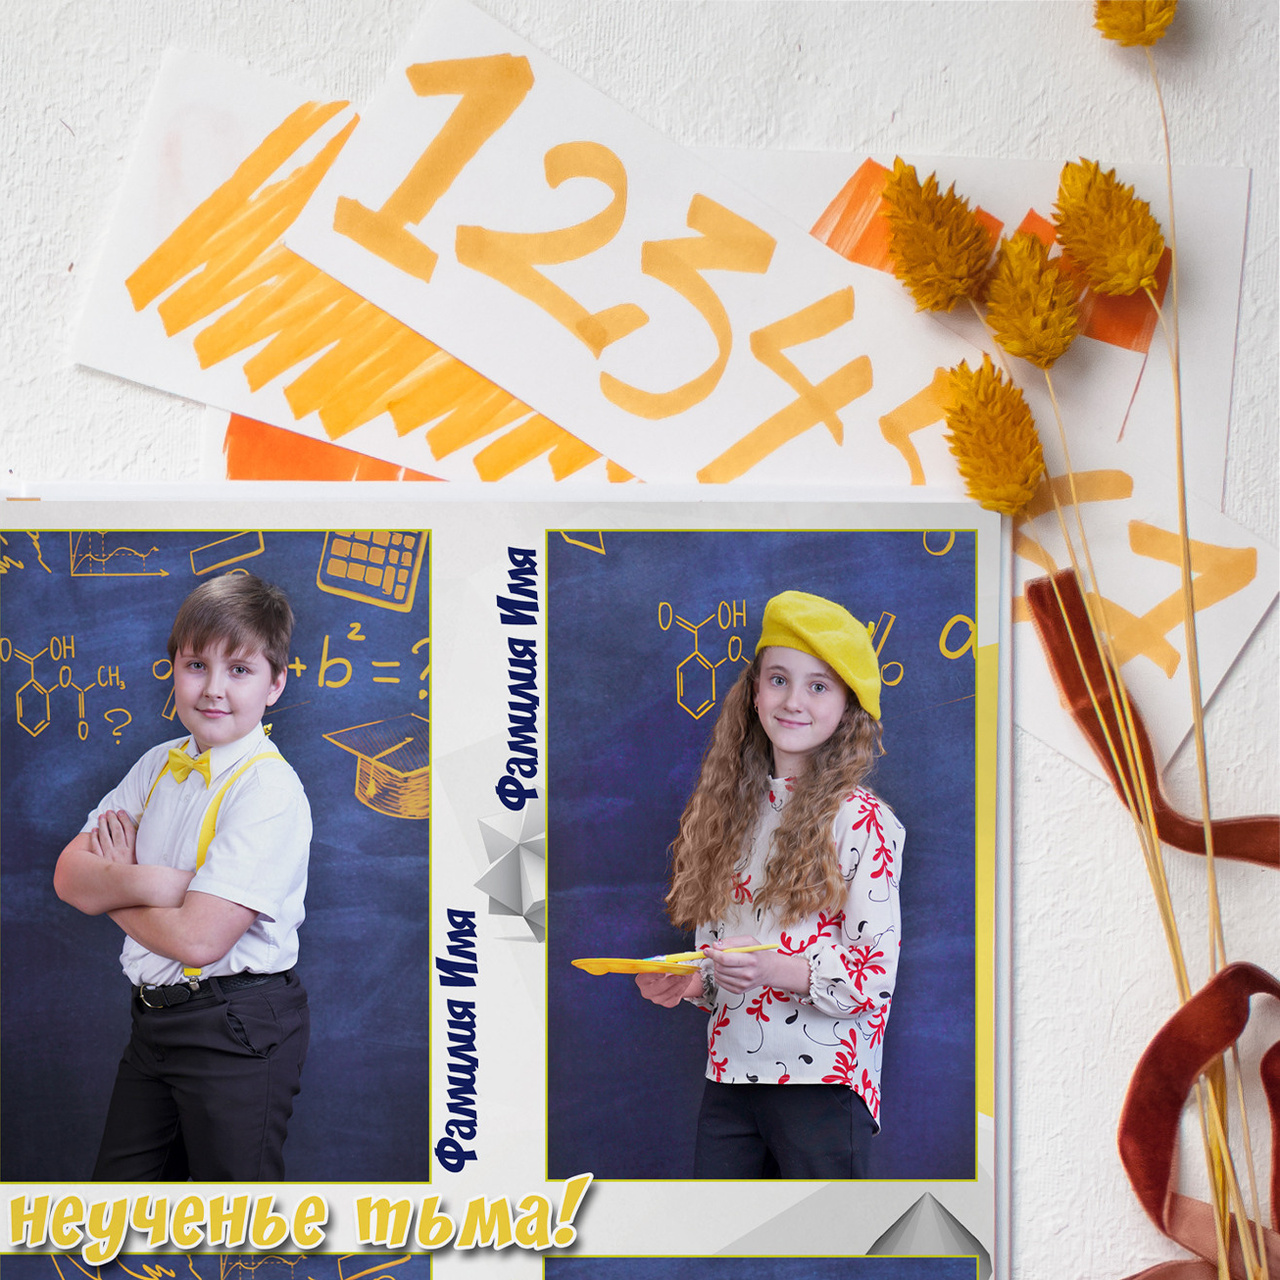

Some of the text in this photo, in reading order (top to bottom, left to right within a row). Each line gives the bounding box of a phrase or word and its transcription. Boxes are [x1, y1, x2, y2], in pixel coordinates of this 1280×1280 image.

[495, 546, 540, 811] Фамилия Имя
[435, 908, 479, 1173] Фамилия Имя
[9, 1194, 326, 1264] неученье
[355, 1175, 591, 1248] тьма!
